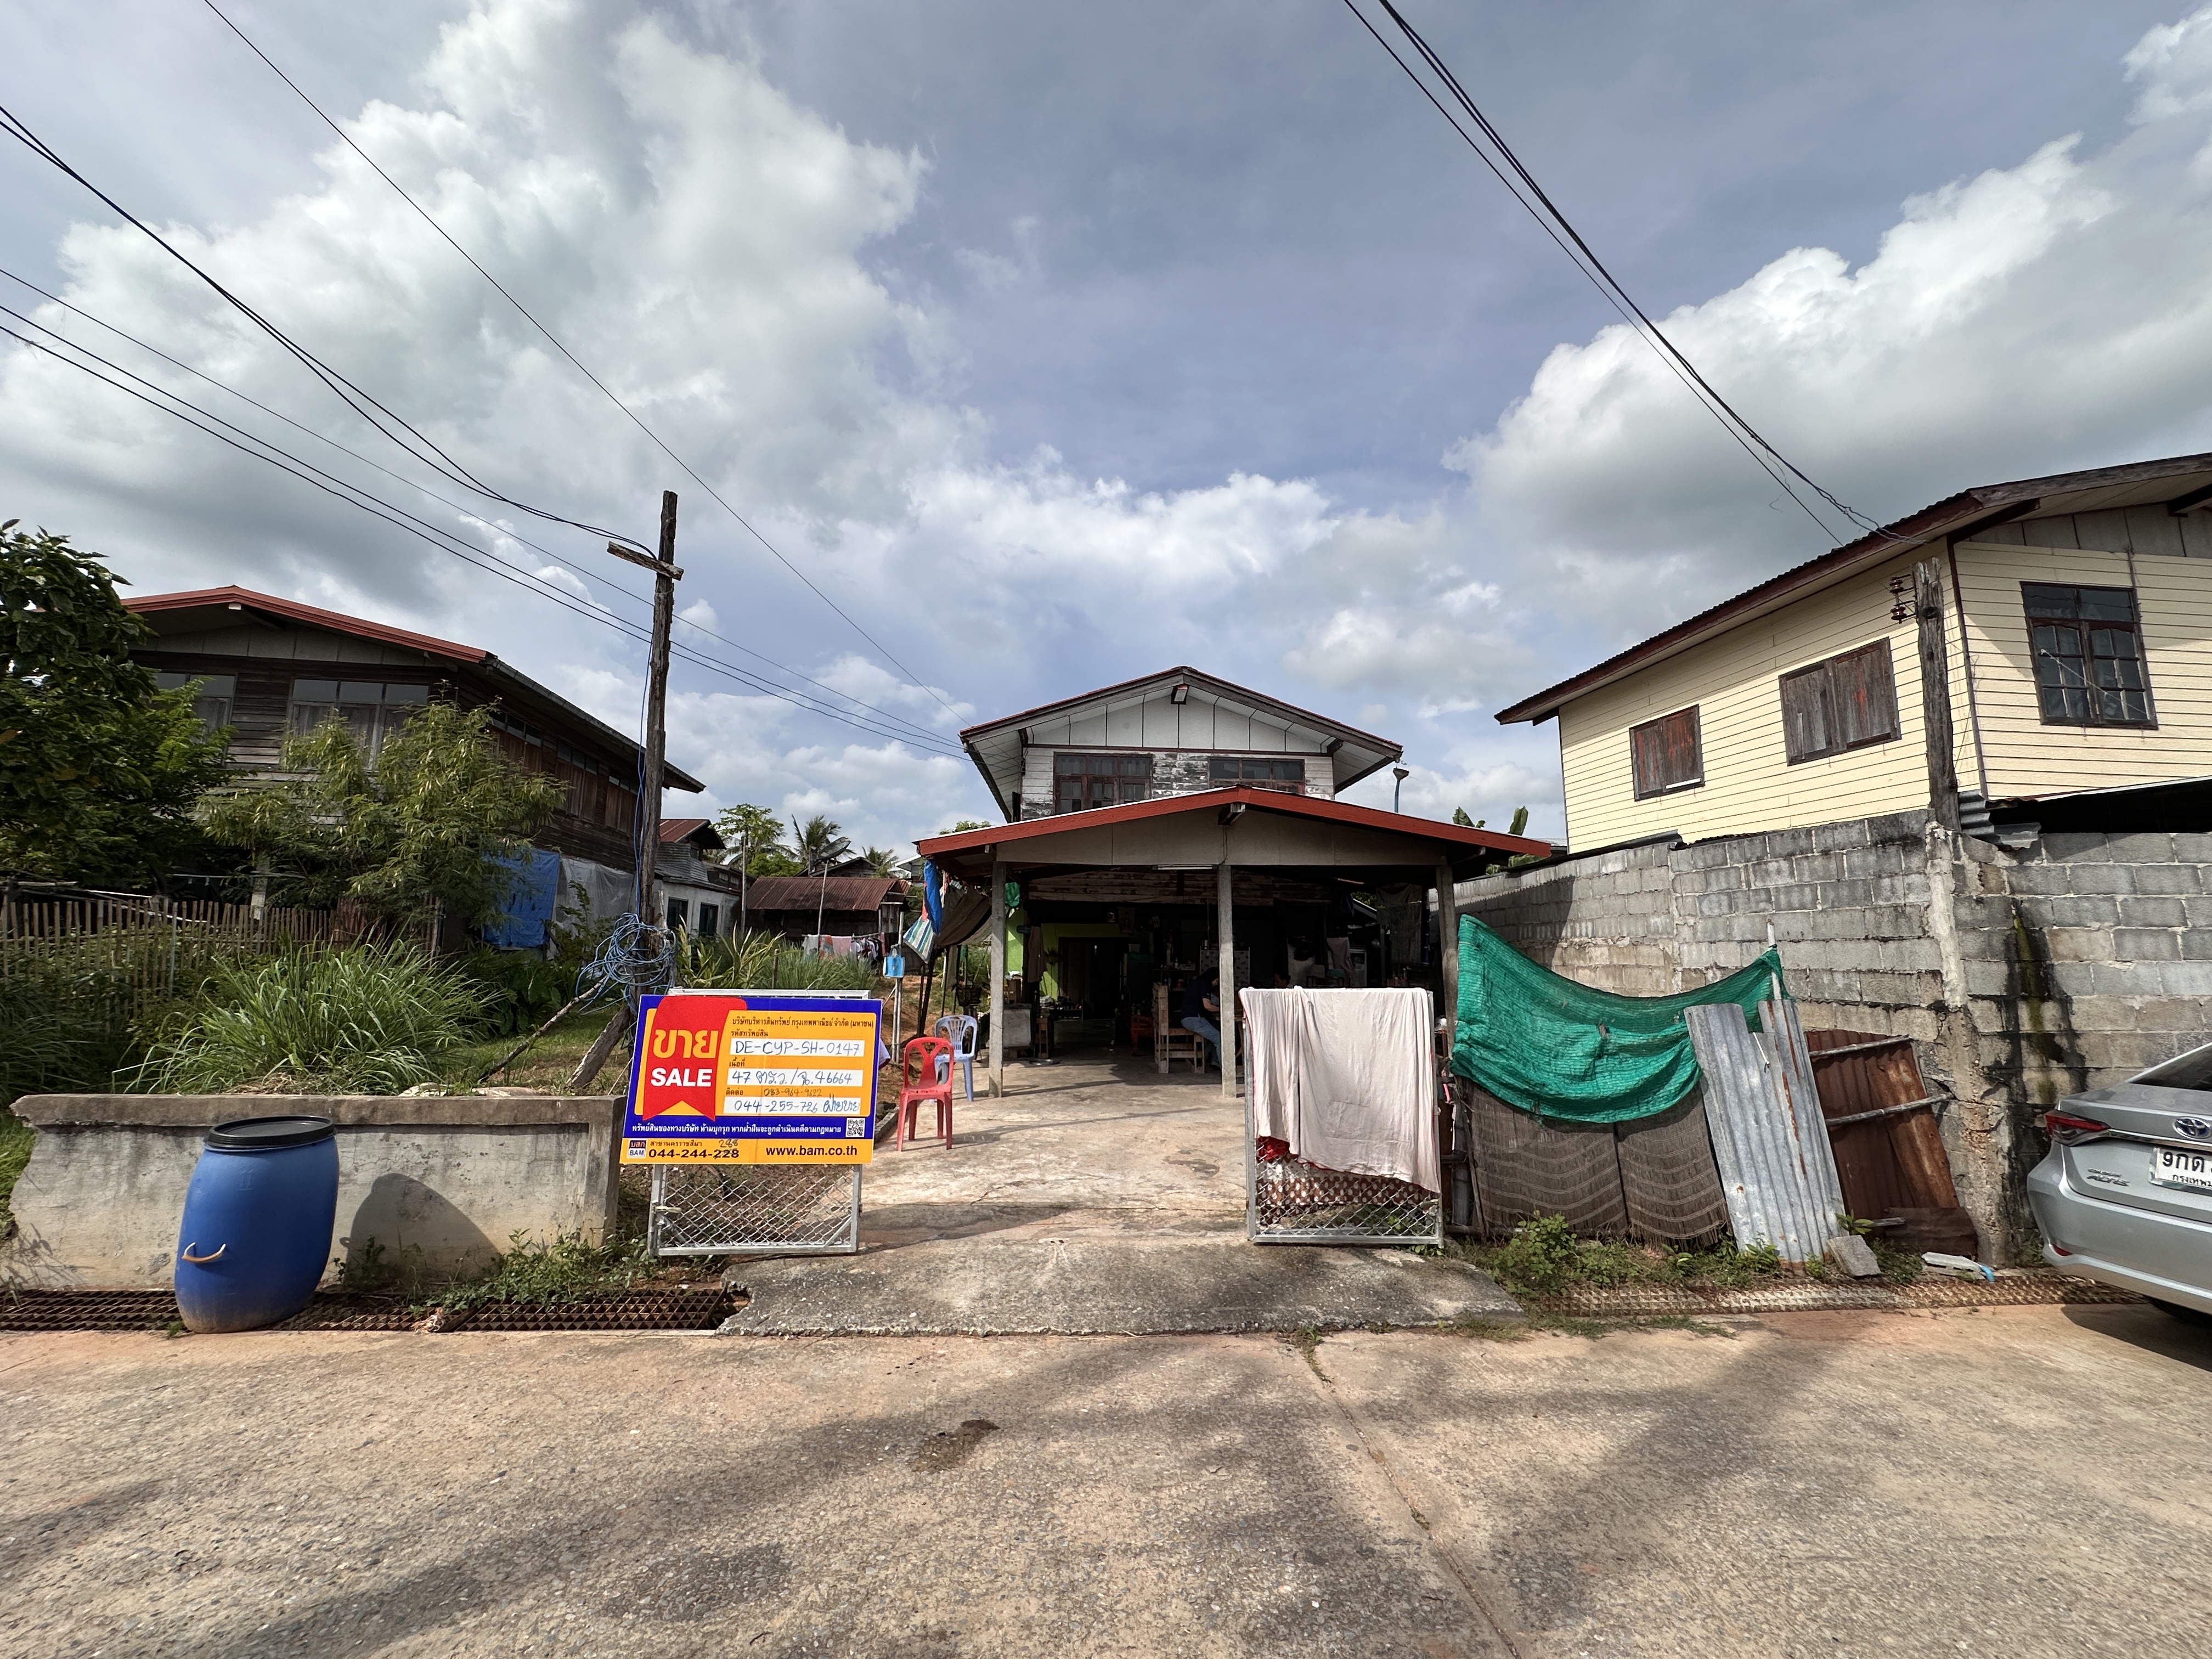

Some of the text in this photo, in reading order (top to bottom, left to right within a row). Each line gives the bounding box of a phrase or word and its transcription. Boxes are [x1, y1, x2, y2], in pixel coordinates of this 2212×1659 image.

[732, 1017, 874, 1029] บริษัทบริหารสินทรัพย์ กรุงเทพพาณิชย์ จำกัด (มหาชน)
[653, 1029, 719, 1058] ขาย
[736, 1041, 860, 1056] DE-CYP-SH-0147
[729, 1057, 746, 1068] เนื้อที่
[650, 1068, 713, 1087] SALE
[732, 1070, 751, 1084] 47
[726, 1087, 744, 1096] ติดต่อ
[632, 1122, 699, 1132] ทรัพย์สินของทางบริษัท
[701, 1124, 730, 1135] ห้ามบุกรุก
[648, 1149, 739, 1158] 044-244-228
[766, 1145, 857, 1155] www.bam.co.th
